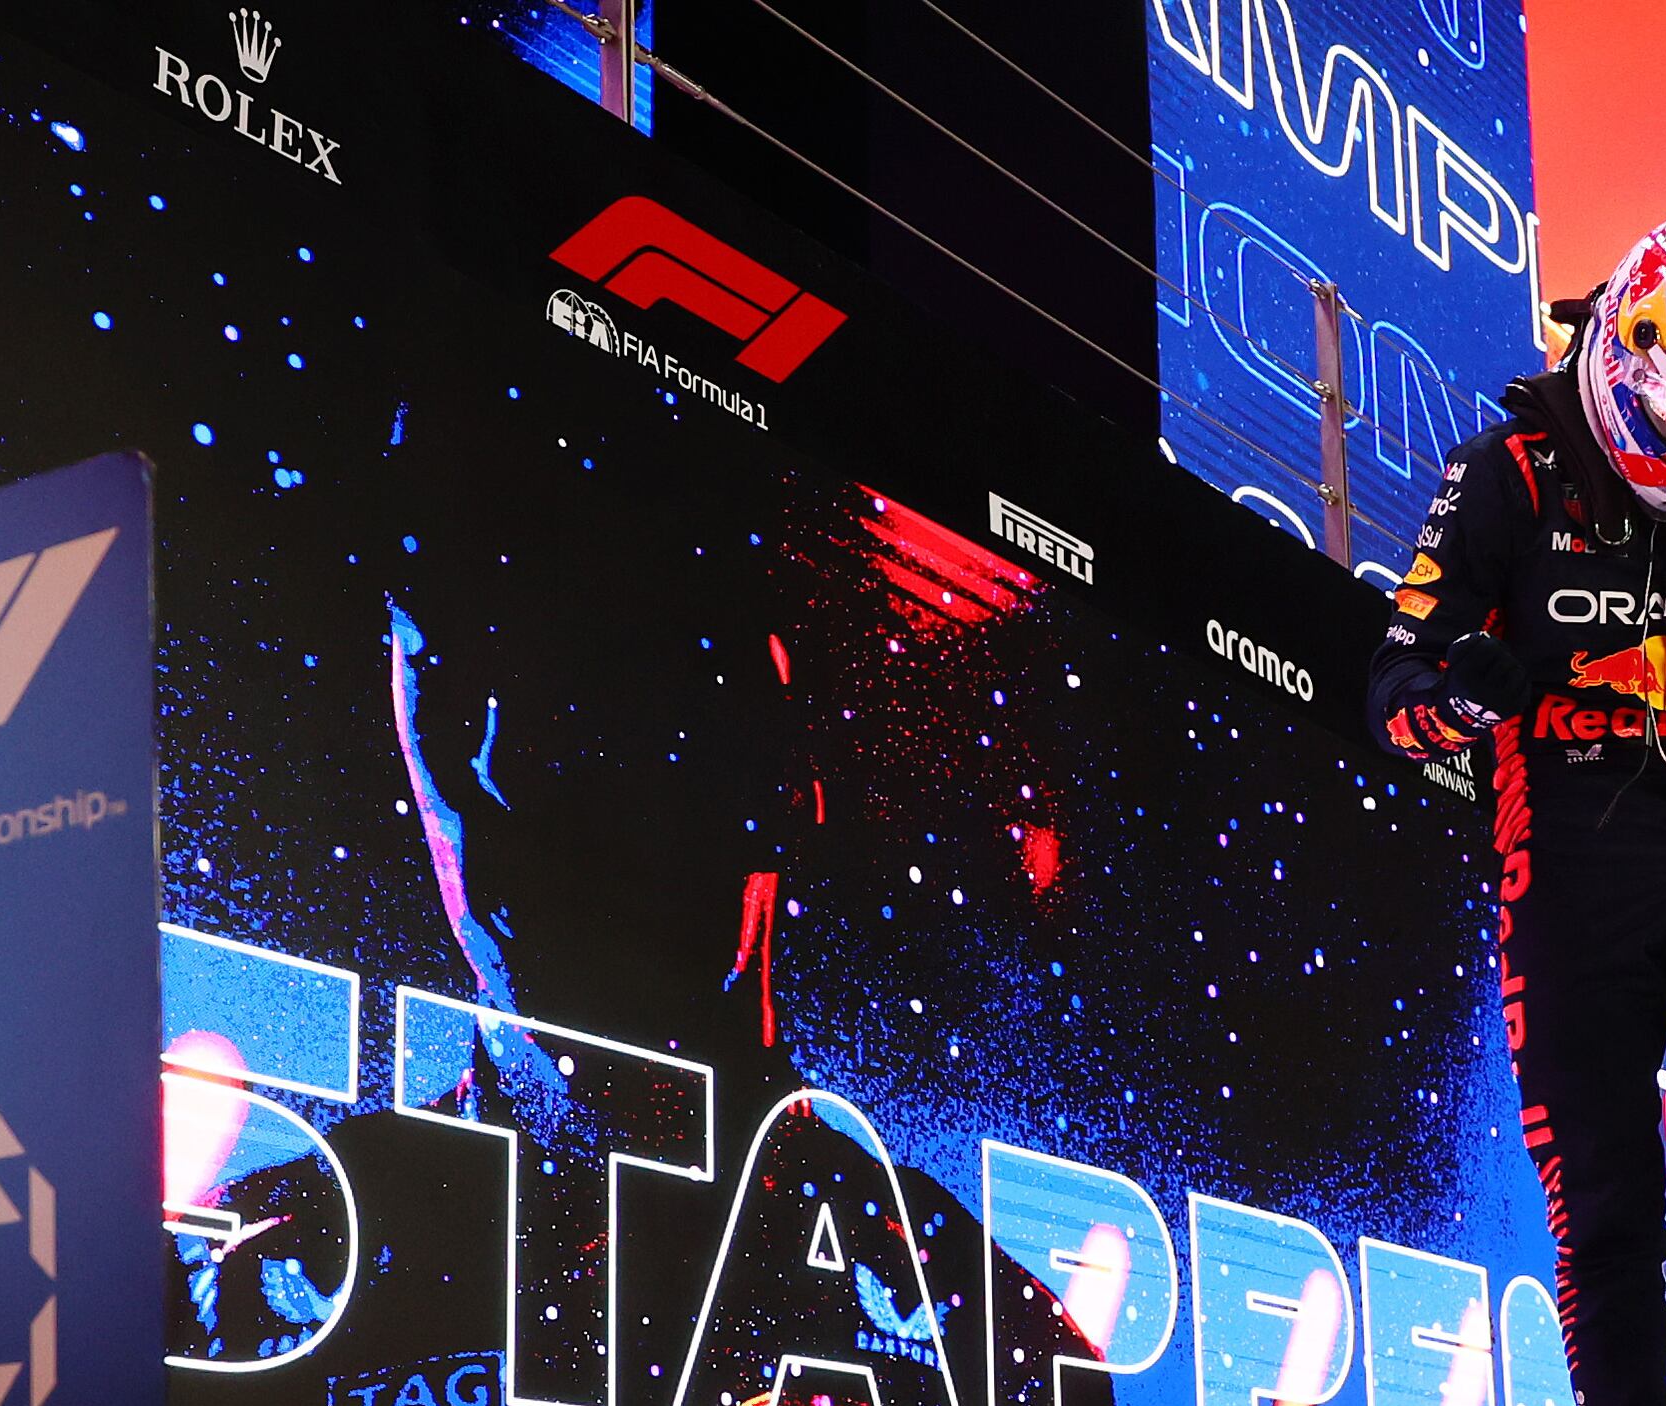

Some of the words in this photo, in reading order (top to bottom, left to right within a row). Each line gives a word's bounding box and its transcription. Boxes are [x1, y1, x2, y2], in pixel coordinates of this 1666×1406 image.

[152, 46, 342, 185] ROLEX
[549, 195, 849, 384] F1
[623, 331, 661, 374] FIA
[663, 354, 755, 423] Formula
[755, 403, 769, 431] 1
[988, 491, 1094, 586] PIRELLI
[1206, 619, 1314, 702] aramco
[1423, 761, 1476, 802] AIRWAYS
